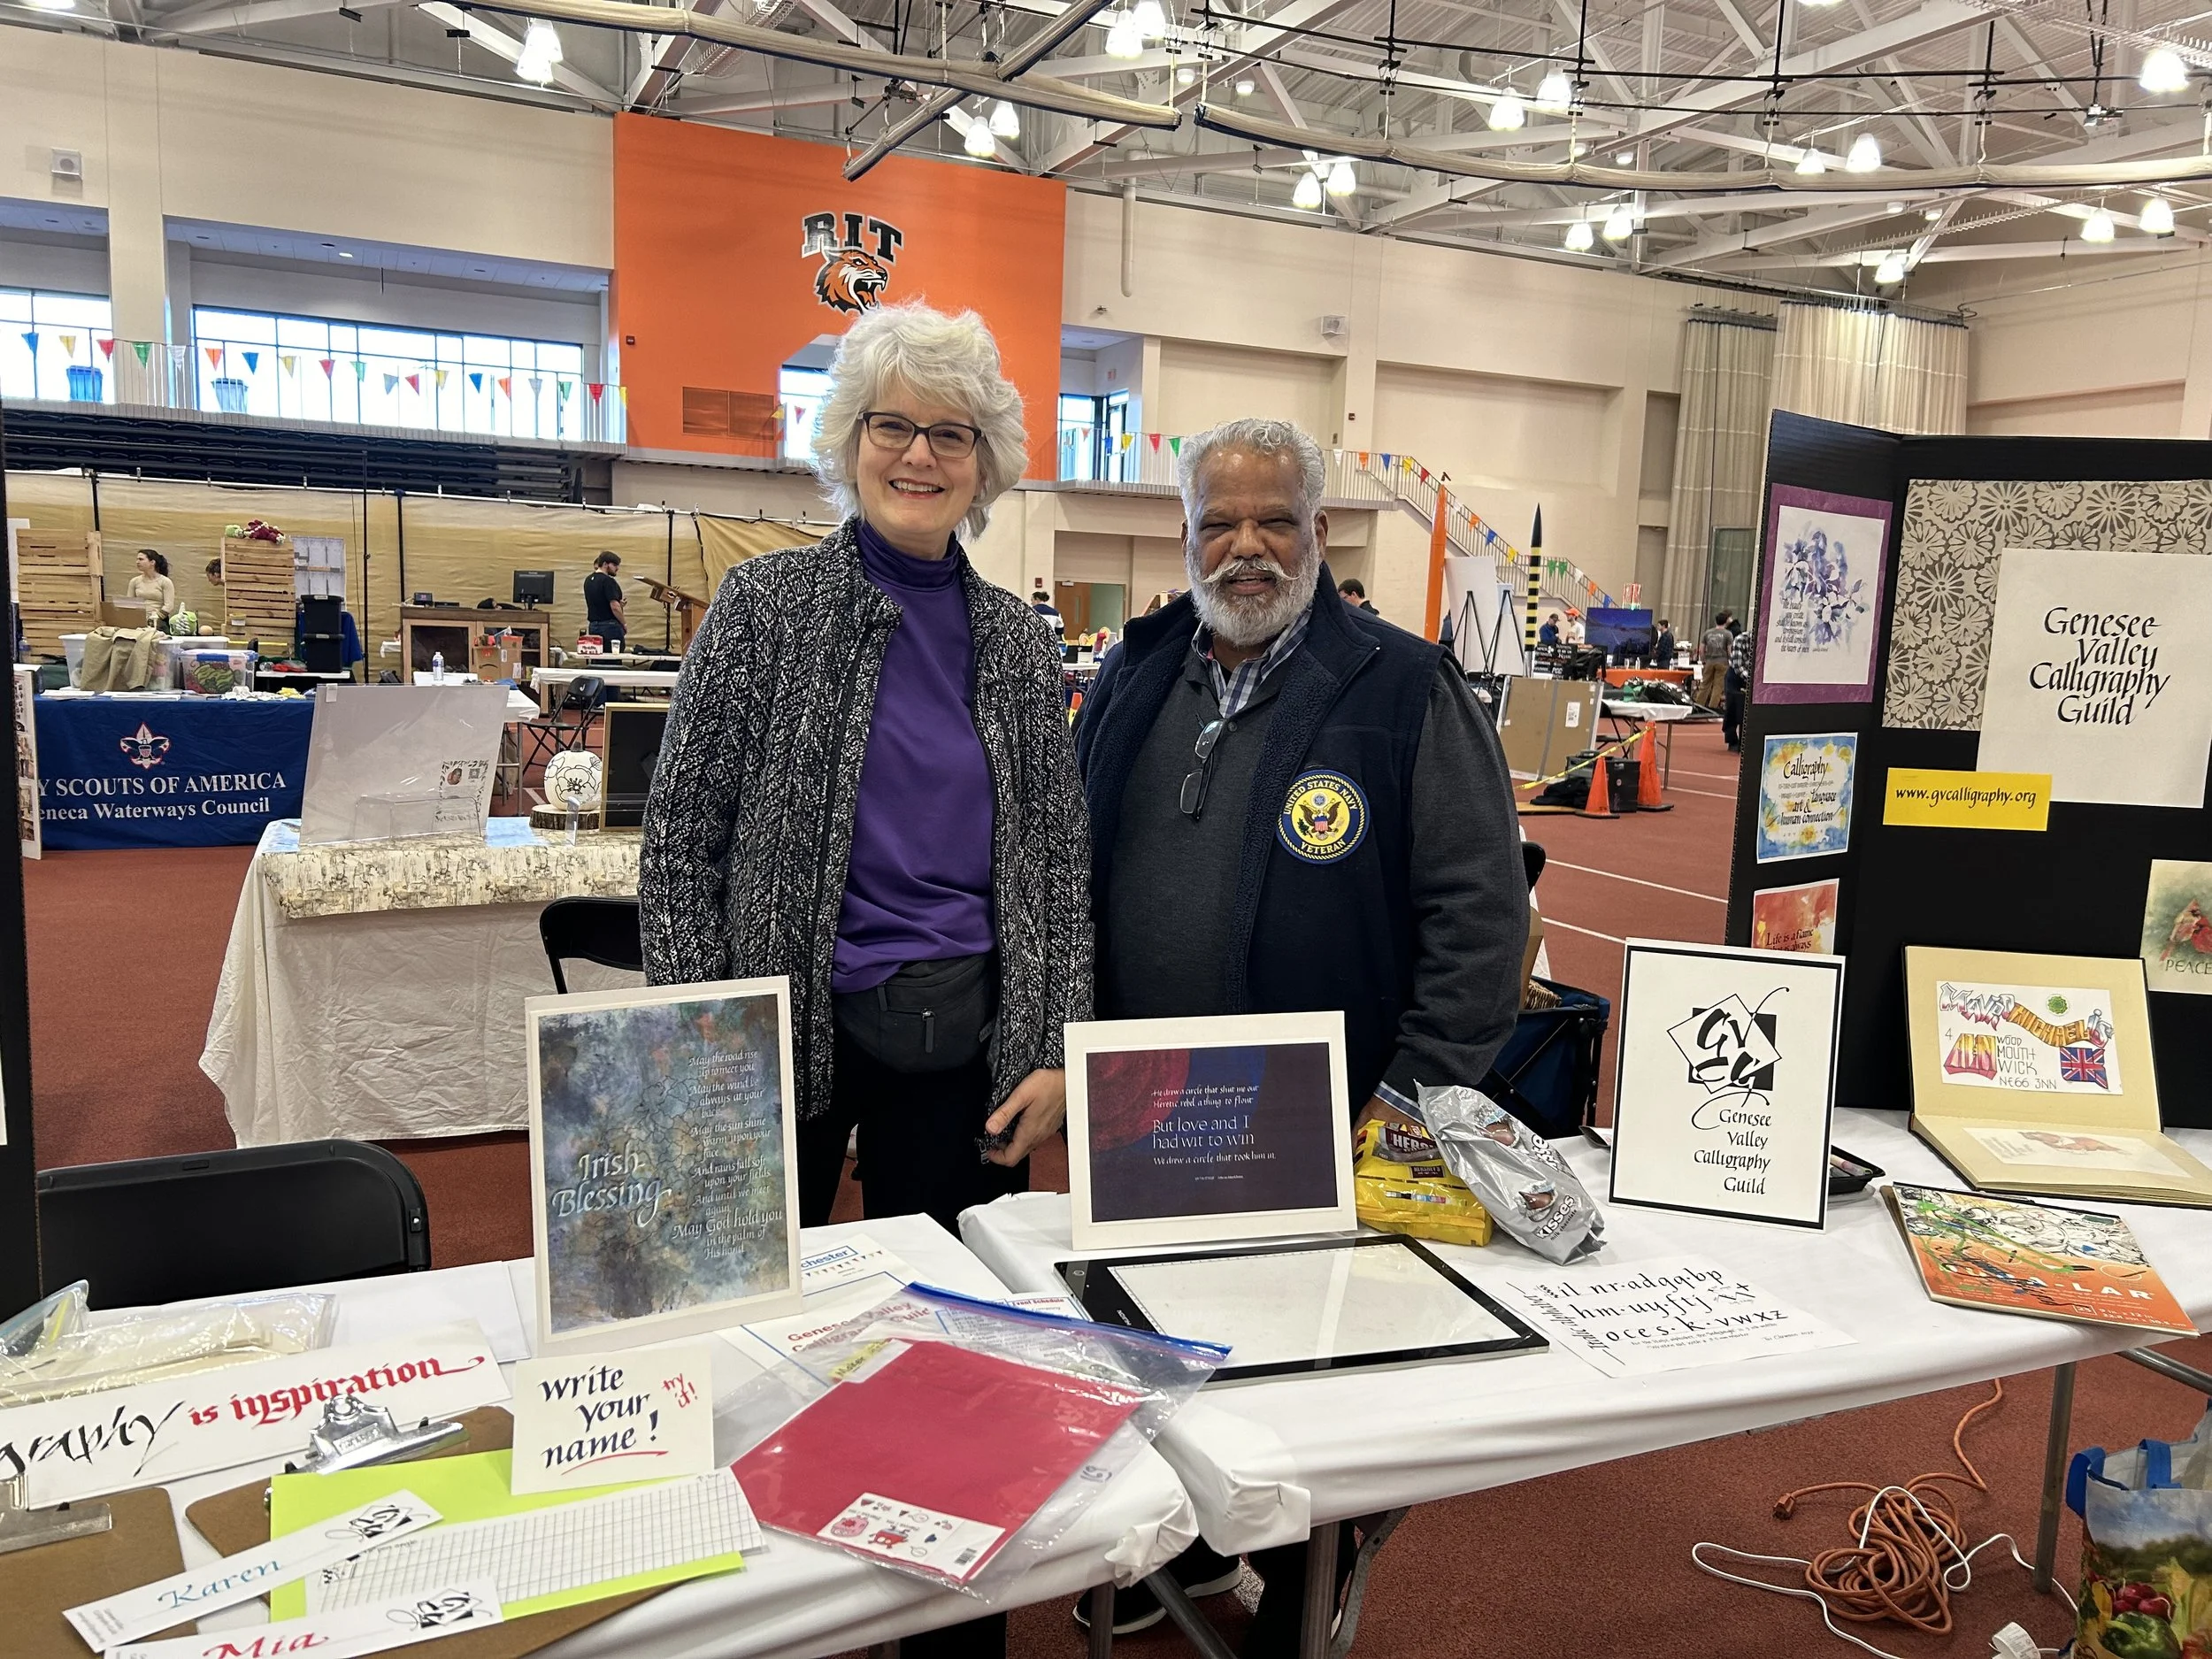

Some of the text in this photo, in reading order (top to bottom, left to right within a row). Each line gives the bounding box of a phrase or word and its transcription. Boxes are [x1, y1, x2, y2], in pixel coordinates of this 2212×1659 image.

[803, 211, 903, 265] RIT
[2044, 607, 2162, 637] Genesee
[2077, 636, 2159, 672] Valley
[2029, 657, 2170, 709] Calligraphy
[2056, 694, 2137, 725] Guild
[1783, 752, 1829, 781] Calligraphy
[56, 776, 144, 797] SCOUTS
[150, 776, 180, 795] OF
[184, 772, 287, 795] AMERICA
[1283, 780, 1358, 815] UNITED STATES NAVY
[1895, 787, 2037, 809] www.gvcalligraphy.org
[39, 797, 270, 822] eneca Waterways Council
[1780, 810, 1833, 826] human connection
[1300, 839, 1347, 856] VETERAN
[1766, 932, 1782, 947] Life
[1783, 933, 1789, 941] is
[1795, 928, 1815, 940] flame
[2165, 959, 2212, 975] PEACE
[1945, 1027, 1953, 1041] 4
[1996, 1034, 2023, 1047] WOOD
[688, 1055, 710, 1068] May
[712, 1049, 723, 1062] the
[725, 1048, 744, 1062] road
[1996, 1045, 2037, 1061] MOUTH
[740, 1062, 755, 1076] you
[1997, 1058, 2038, 1076] WICK
[688, 1082, 711, 1095] May
[712, 1080, 726, 1092] the
[726, 1075, 749, 1091] wind
[1185, 1084, 1202, 1096] circle
[1204, 1084, 1218, 1095] that
[1999, 1076, 2057, 1090] NE66 3NN
[699, 1093, 731, 1108] always
[743, 1087, 766, 1106] your
[1203, 1094, 1222, 1110] thing
[1224, 1096, 1233, 1106] to
[1234, 1094, 1255, 1109] flout
[690, 1116, 766, 1138] May the sun shine
[1152, 1114, 1250, 1133] But love and I
[1719, 1109, 1773, 1127] Genesee
[1152, 1133, 1255, 1149] had wit to win
[1726, 1130, 1769, 1150] Valley
[578, 1139, 646, 1181] Irish
[692, 1162, 712, 1178] And
[714, 1161, 735, 1173] rains
[735, 1155, 751, 1175] fall
[1165, 1156, 1185, 1166] drew
[1193, 1150, 1215, 1164] circle
[1216, 1151, 1233, 1163] that
[1233, 1150, 1251, 1162] took
[1251, 1149, 1266, 1161] him
[1694, 1149, 1771, 1174] Calligraphy
[704, 1176, 726, 1190] upon
[726, 1172, 748, 1188] your
[1724, 1176, 1767, 1195] Guild
[551, 1177, 672, 1228] Blessing
[692, 1192, 713, 1207] And
[738, 1187, 750, 1197] we
[672, 1206, 783, 1240] May God hold you
[718, 1232, 733, 1245] the
[731, 1226, 755, 1244] palm
[757, 1223, 768, 1240] of
[703, 1247, 721, 1261] His
[800, 1248, 849, 1269] chester
[862, 1302, 913, 1320] Valley
[188, 1404, 219, 1426] is
[229, 1355, 486, 1430] inspiration
[537, 1364, 626, 1402] write
[662, 1372, 685, 1393] try
[574, 1393, 651, 1433] your
[157, 1557, 283, 1609] Karen
[203, 1632, 330, 1659] Mia
